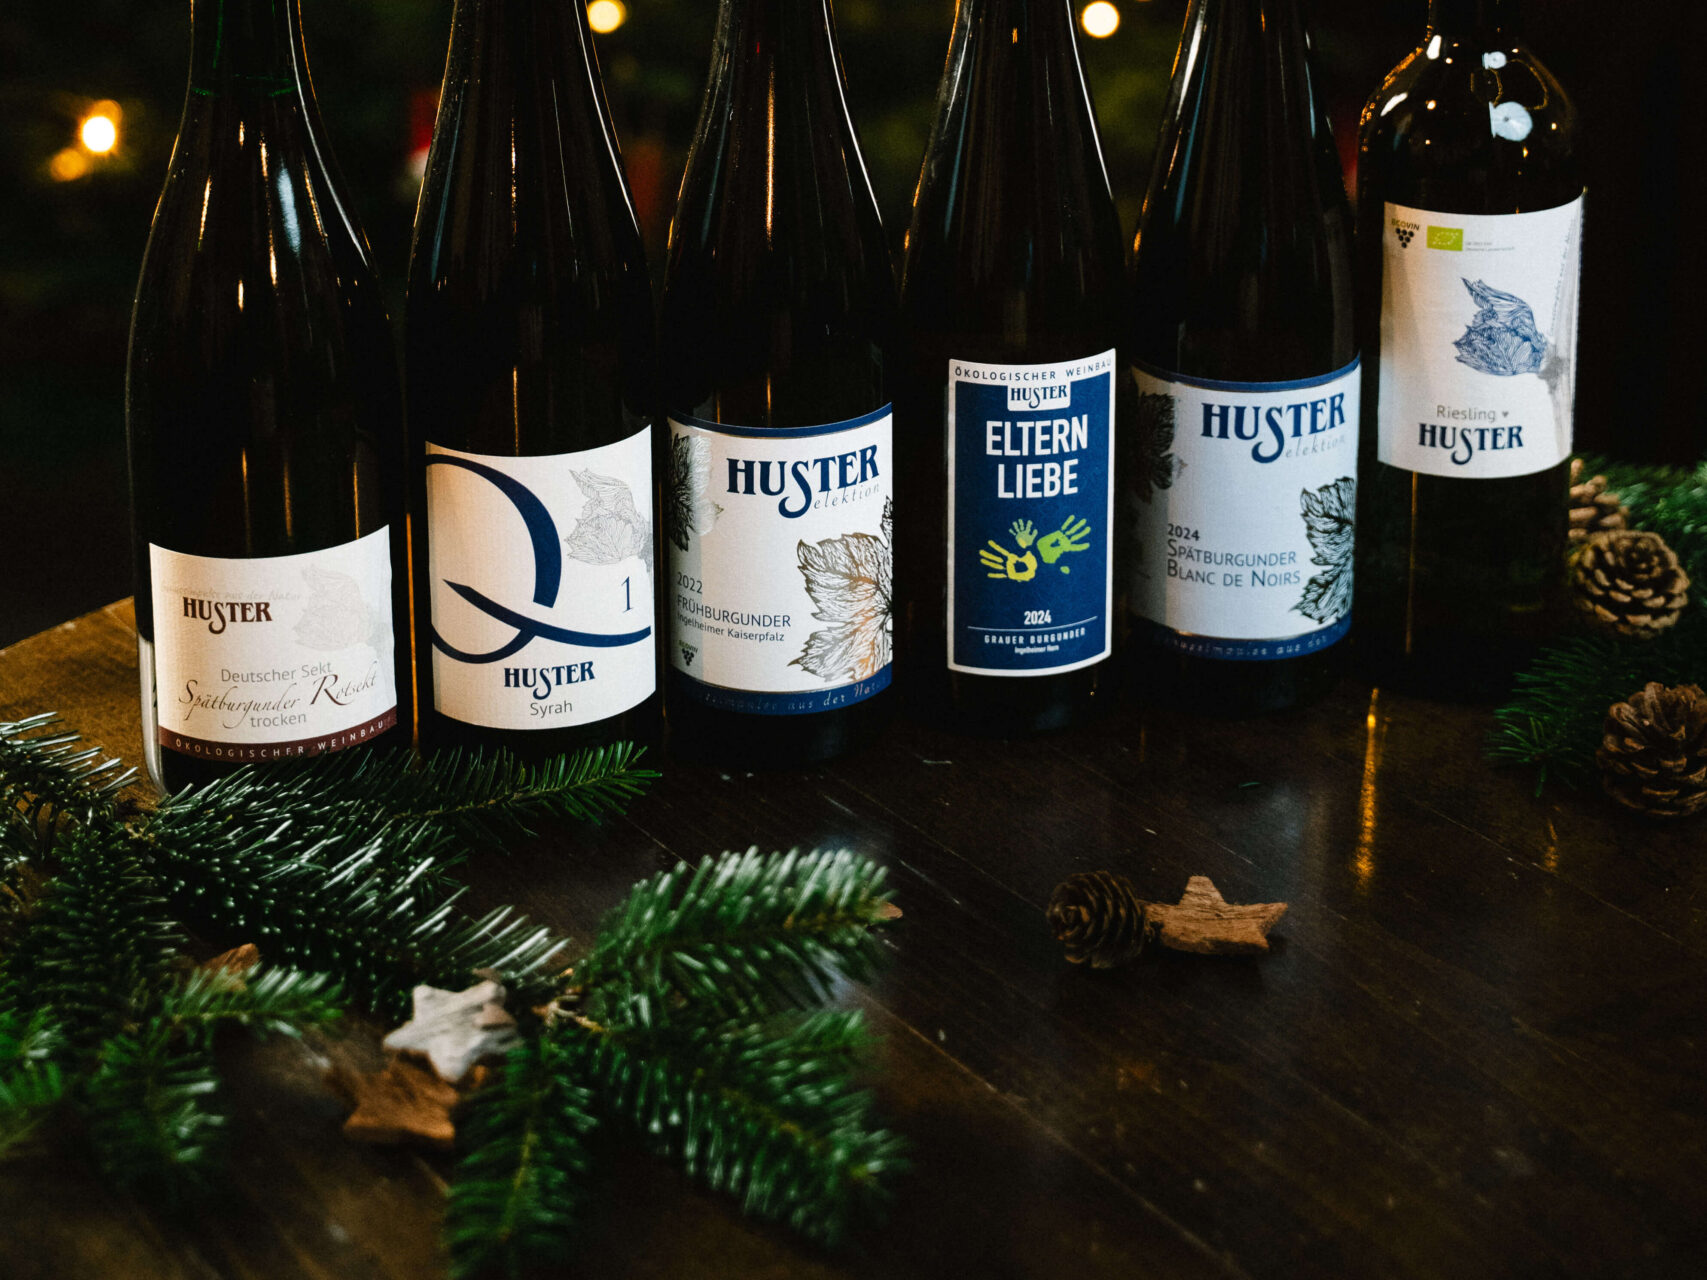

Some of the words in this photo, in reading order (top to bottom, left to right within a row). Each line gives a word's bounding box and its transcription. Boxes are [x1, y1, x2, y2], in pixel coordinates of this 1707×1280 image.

[954, 365, 1056, 381] ÖKOLOGISCHER
[1065, 357, 1112, 377] WEINBAU
[1010, 384, 1068, 409] HUSTER
[1436, 404, 1496, 423] Riesling
[986, 414, 1088, 456] ELTERN
[1200, 392, 1346, 464] HUSTER
[1418, 423, 1524, 465] HUSTER
[726, 444, 880, 519] HUSTER
[998, 459, 1079, 499] LIEBE
[1167, 523, 1200, 541] 2024
[620, 576, 635, 613] 1
[677, 571, 704, 595] 2022
[182, 596, 273, 634] HUSTER
[677, 594, 792, 628] FRÜHBURGUNDER
[1024, 609, 1052, 625] 2024
[727, 628, 785, 643] Kaiserpfalz
[984, 634, 1024, 644] GRAUER
[1029, 627, 1086, 644] BURGUNDER
[221, 669, 297, 684] Deutscher
[301, 661, 332, 678] Sekt
[504, 660, 596, 700] HUSTER
[178, 678, 301, 729] Spätburgunder
[529, 700, 573, 717] Syrah
[250, 712, 307, 729] trocken
